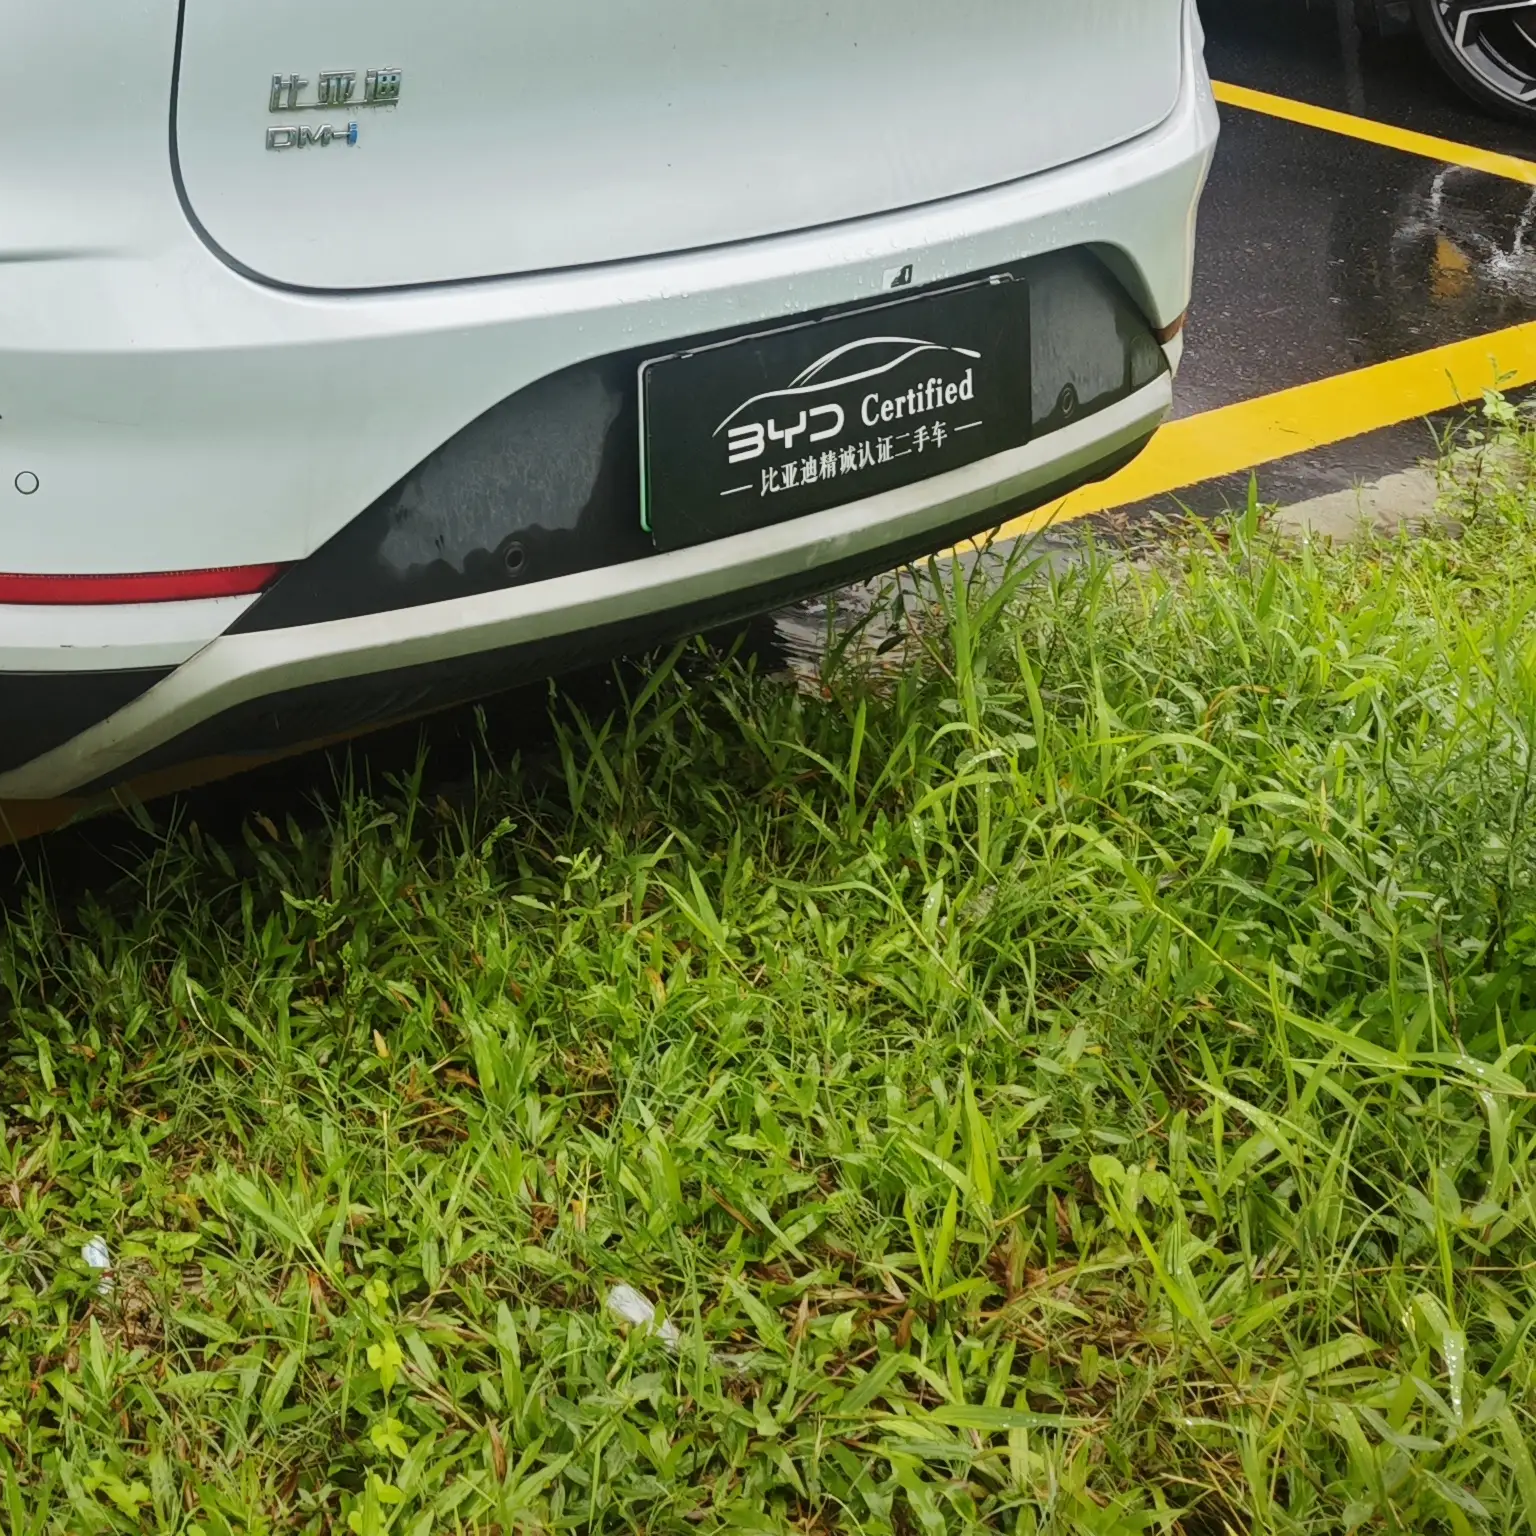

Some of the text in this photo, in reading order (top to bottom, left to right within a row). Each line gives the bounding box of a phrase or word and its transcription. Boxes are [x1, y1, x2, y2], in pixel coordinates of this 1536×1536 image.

[268, 67, 403, 114] 比亚迪
[727, 368, 974, 464] BYD Certified
[760, 420, 948, 497] 比亚迪精诚认证二手车
